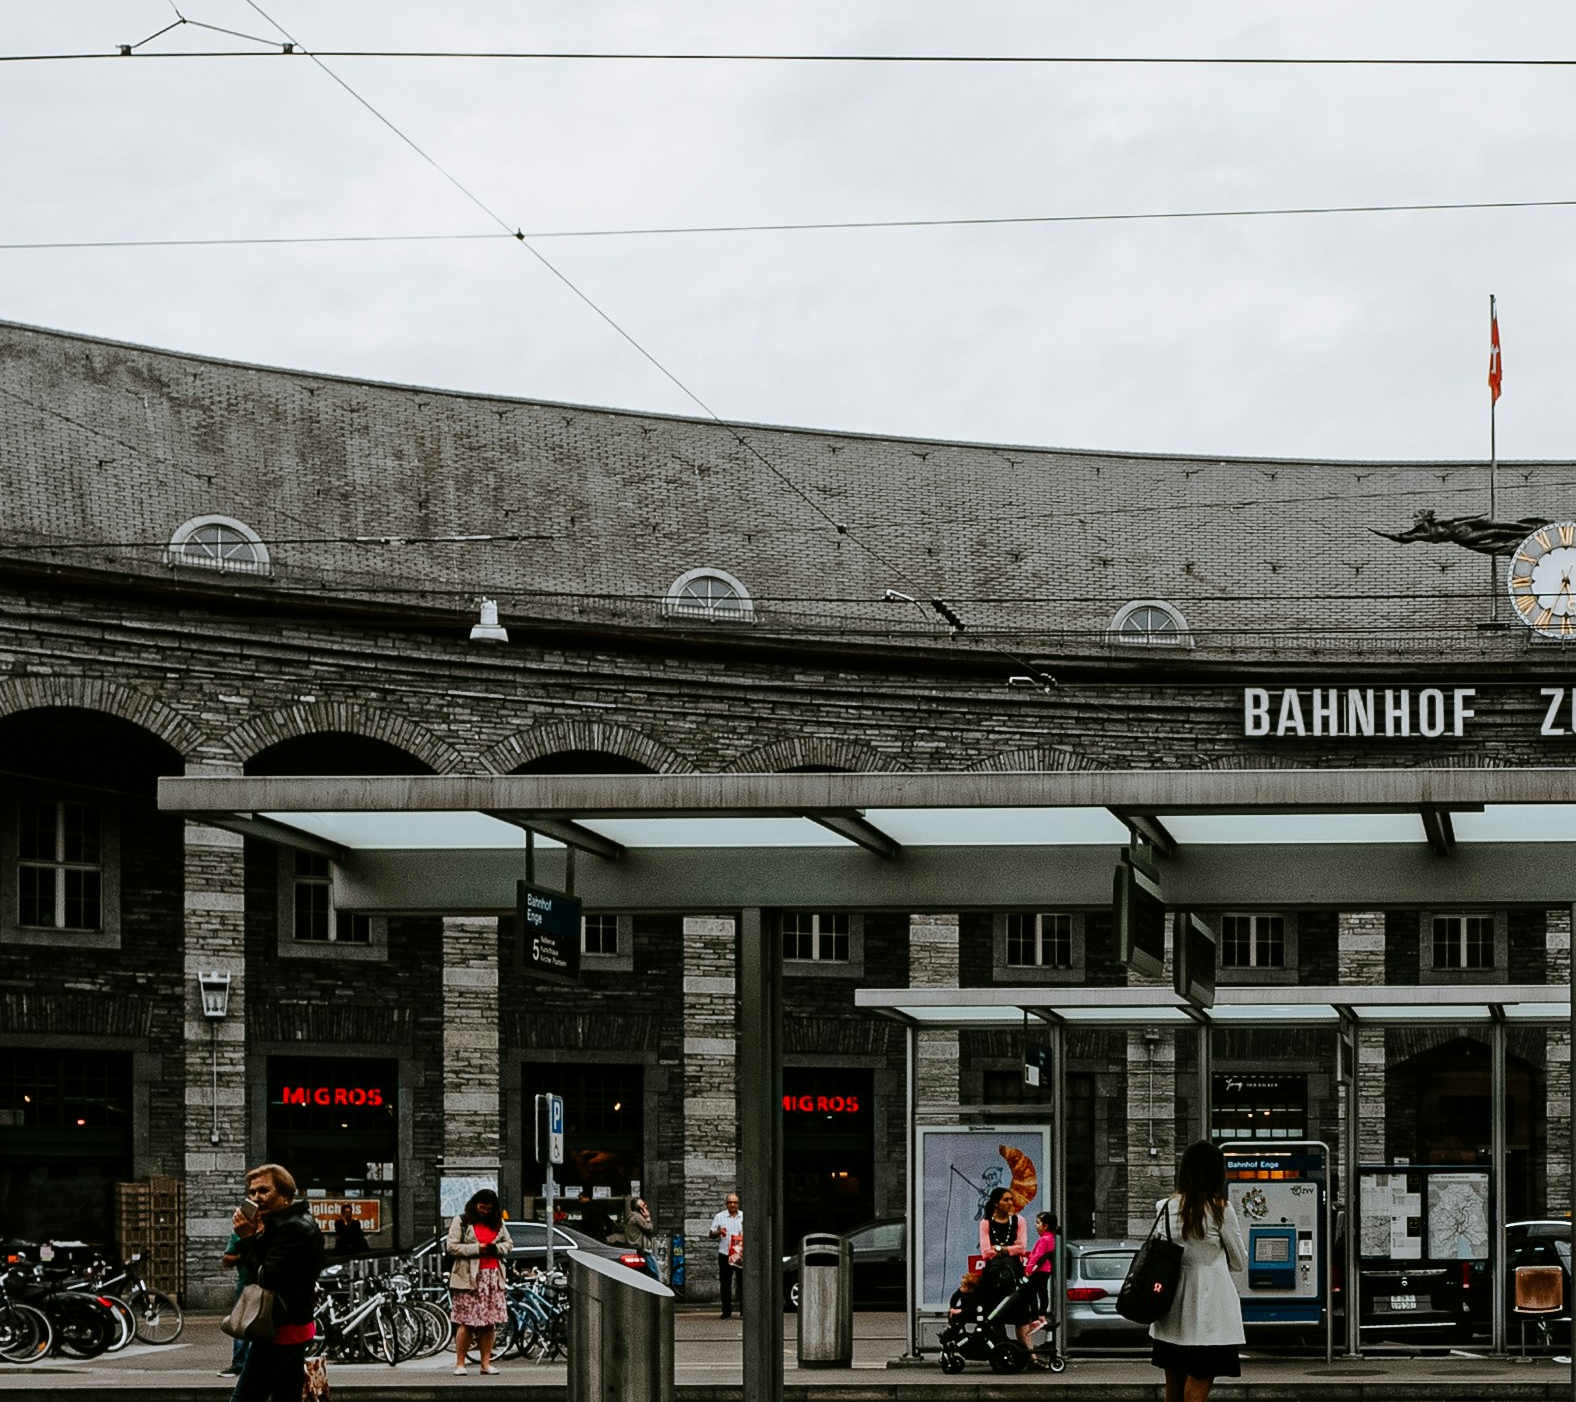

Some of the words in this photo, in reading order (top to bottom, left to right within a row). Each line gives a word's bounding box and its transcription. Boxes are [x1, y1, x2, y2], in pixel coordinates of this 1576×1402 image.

[1244, 688, 1475, 737] BAHNHOF
[527, 893, 552, 911] Bahnhof
[527, 908, 542, 926] Enge
[532, 939, 540, 961] 5
[282, 1086, 384, 1106] MIGROS
[553, 1101, 562, 1130] P
[1227, 1161, 1258, 1169] Bahnhof
[1260, 1161, 1279, 1169] Enge
